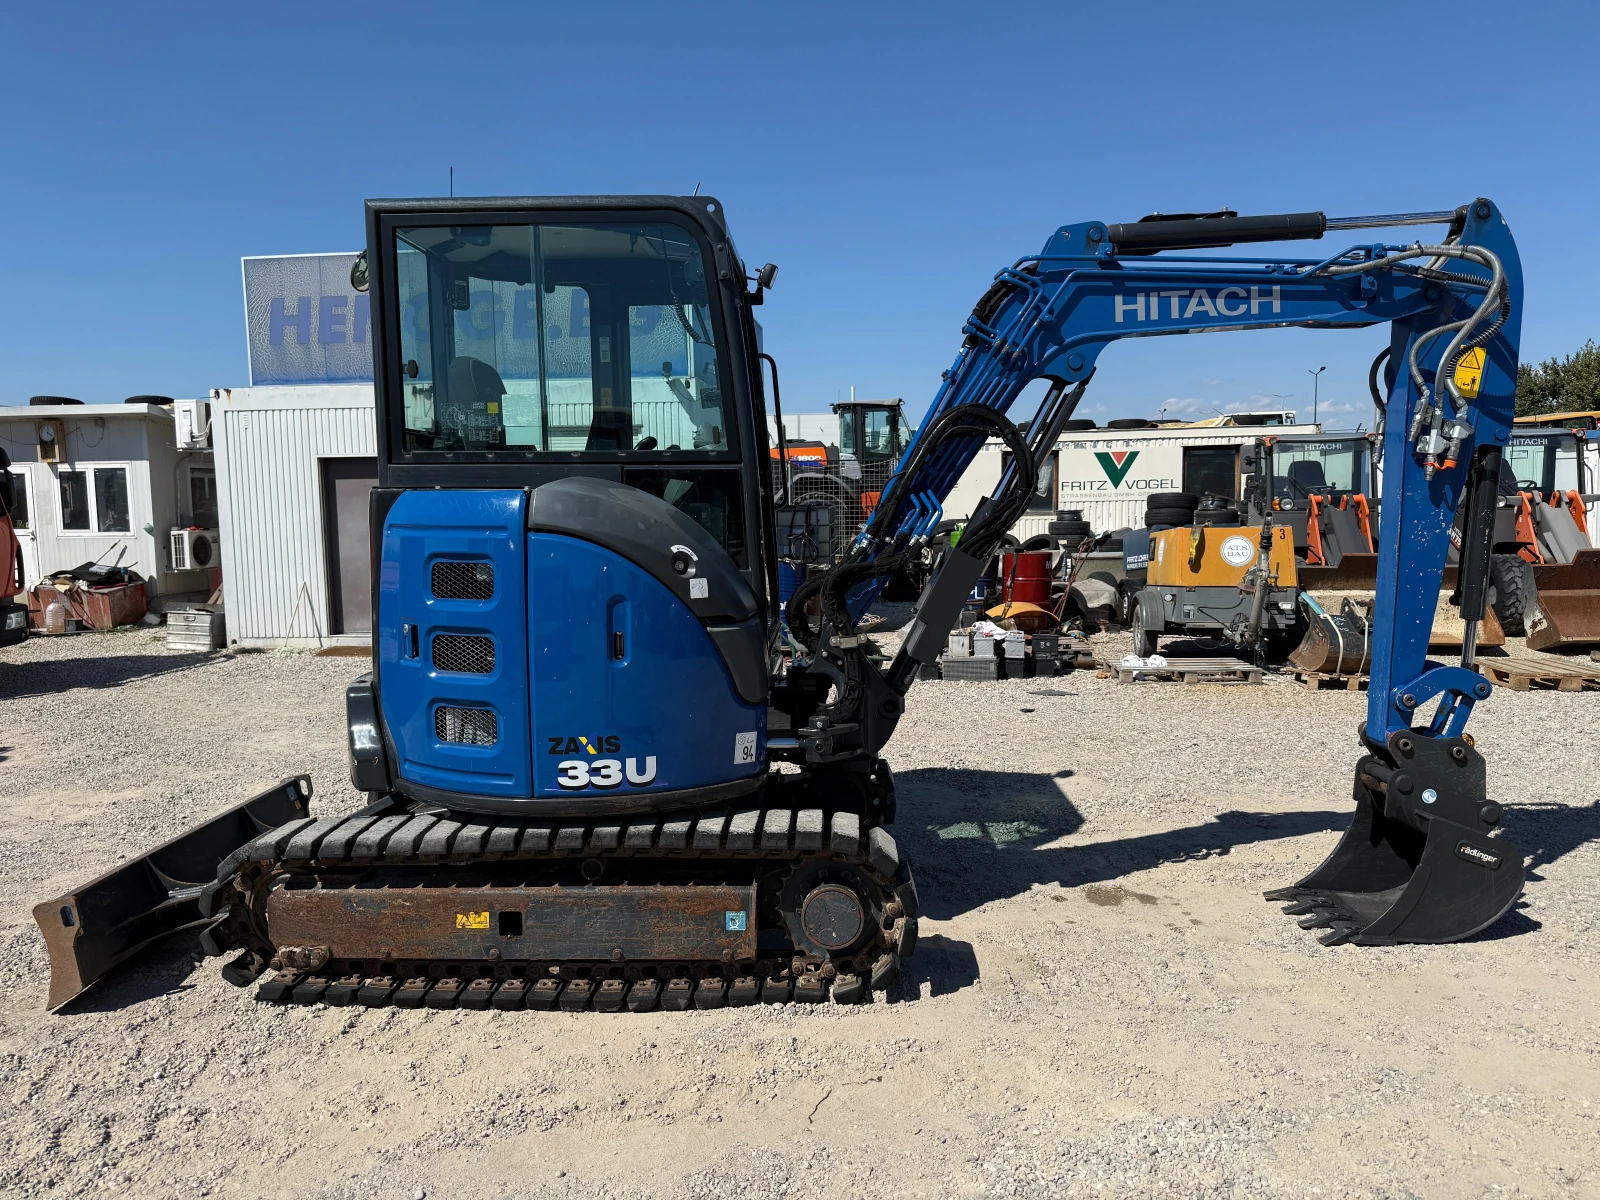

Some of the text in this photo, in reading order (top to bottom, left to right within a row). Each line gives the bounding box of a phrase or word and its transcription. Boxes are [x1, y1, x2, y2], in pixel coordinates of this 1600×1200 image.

[1061, 479, 1180, 491] FRITZ VOGEL
[1279, 528, 1286, 540] 3
[548, 735, 621, 755] ZAXIS
[742, 745, 754, 761] 94
[557, 756, 657, 790] 33U
